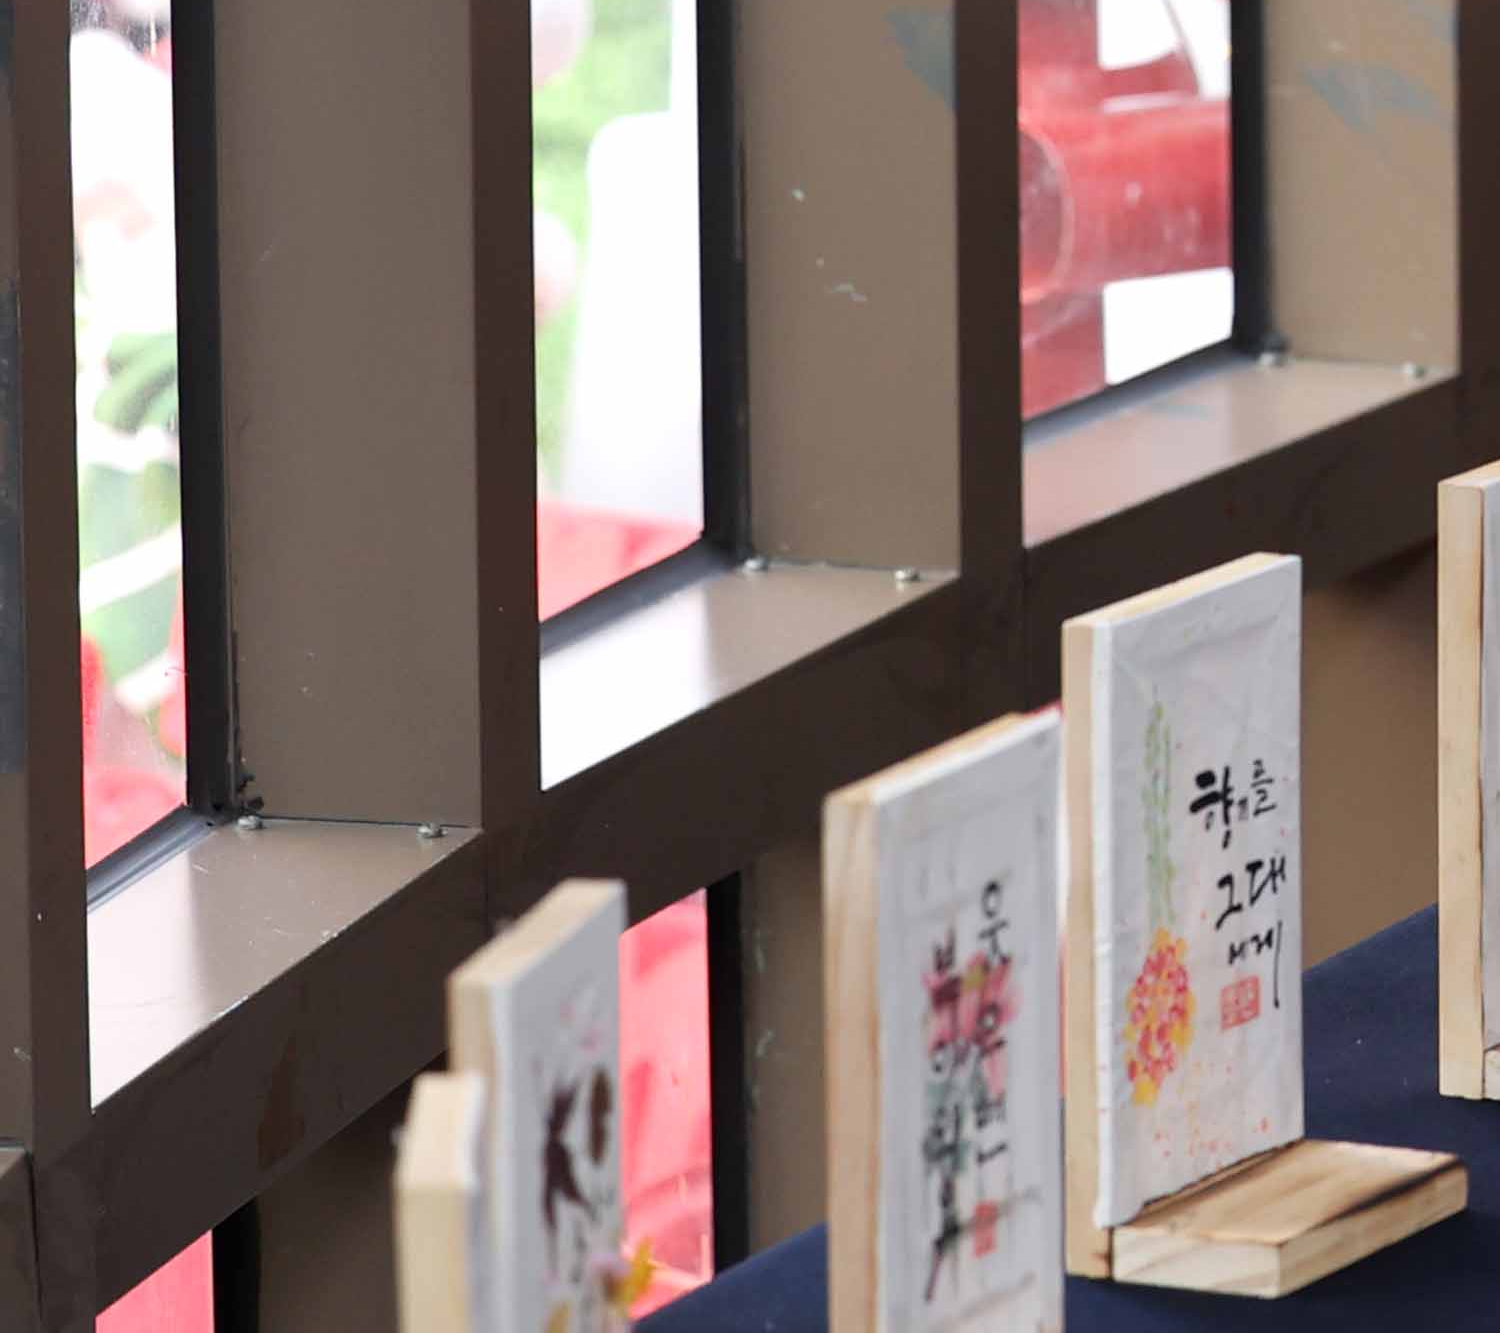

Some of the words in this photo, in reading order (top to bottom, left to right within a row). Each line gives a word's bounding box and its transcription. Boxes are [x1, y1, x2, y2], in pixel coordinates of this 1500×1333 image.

[1188, 758, 1279, 852] 향기를
[1214, 854, 1288, 933] 그대
[1226, 918, 1284, 1011] 에게
